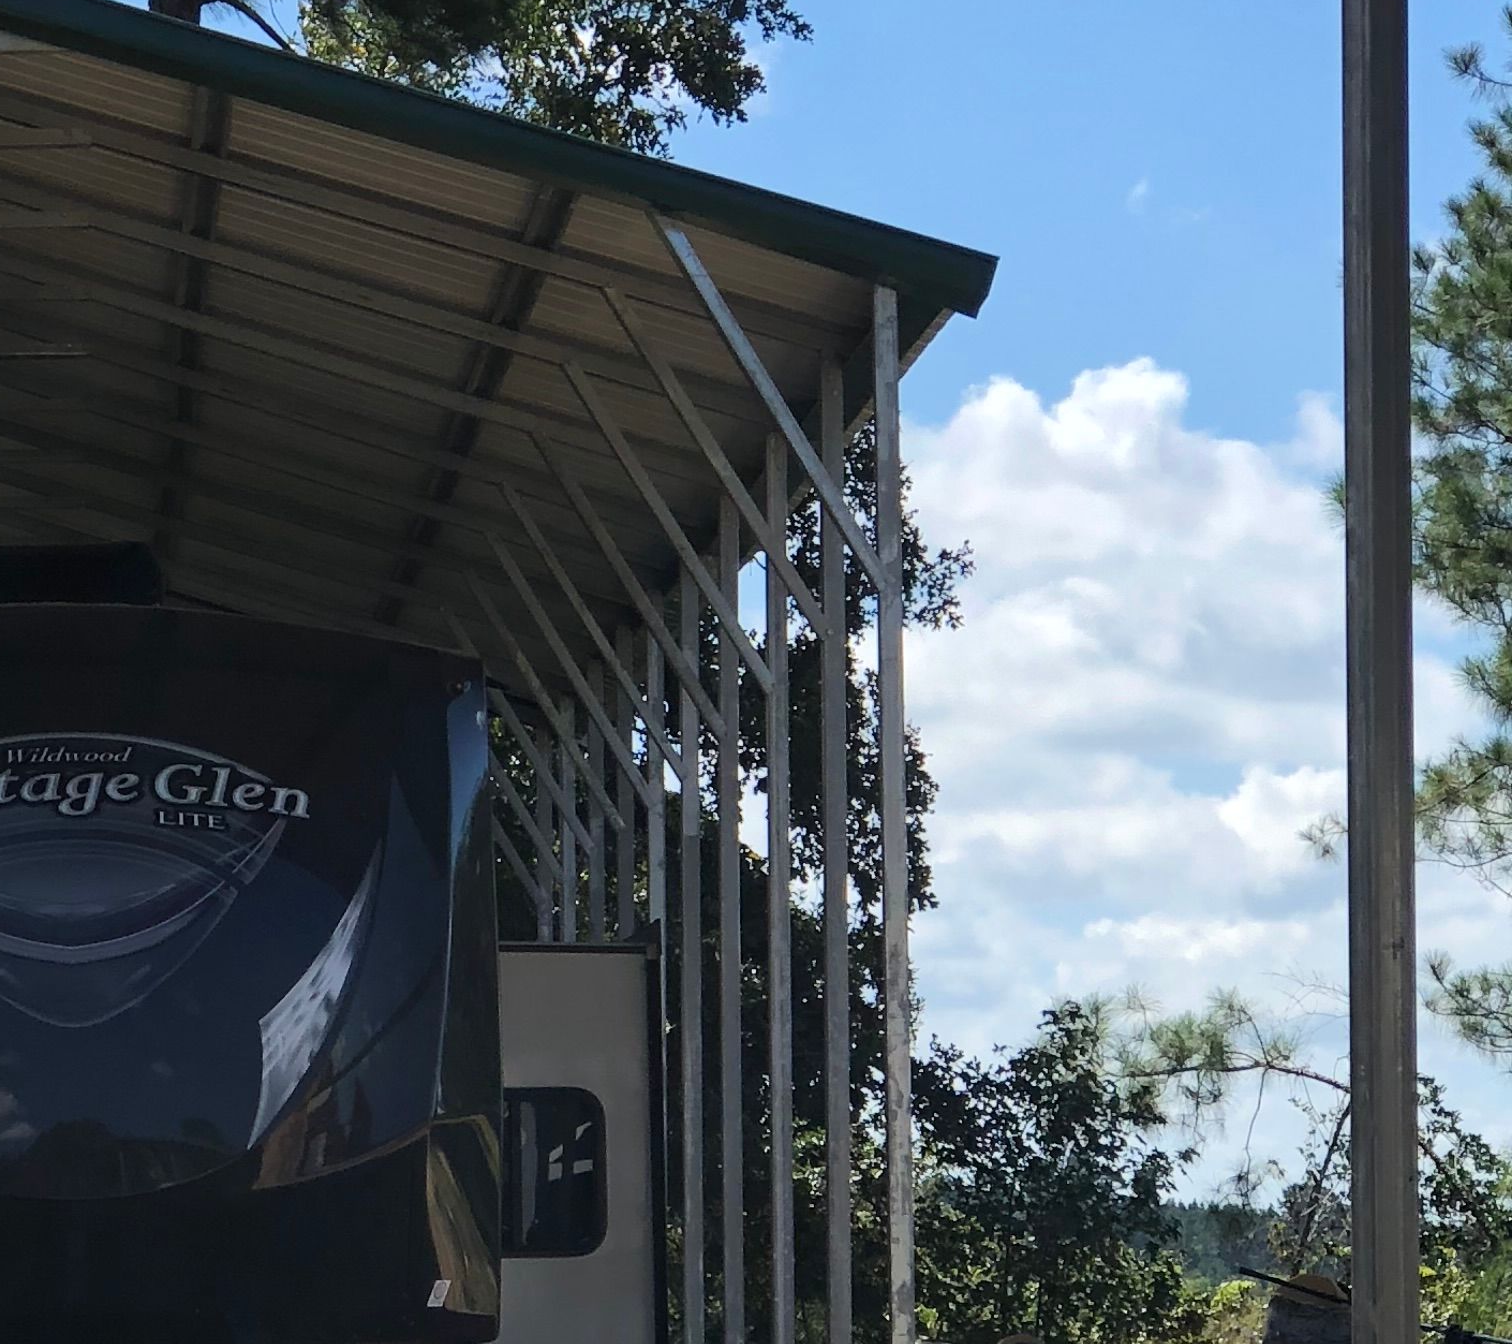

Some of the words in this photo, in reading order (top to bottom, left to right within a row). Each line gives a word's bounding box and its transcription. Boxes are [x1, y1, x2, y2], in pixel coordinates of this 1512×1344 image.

[7, 746, 135, 764] Wildwood
[153, 763, 311, 819] Glen
[159, 809, 227, 830] LITE
